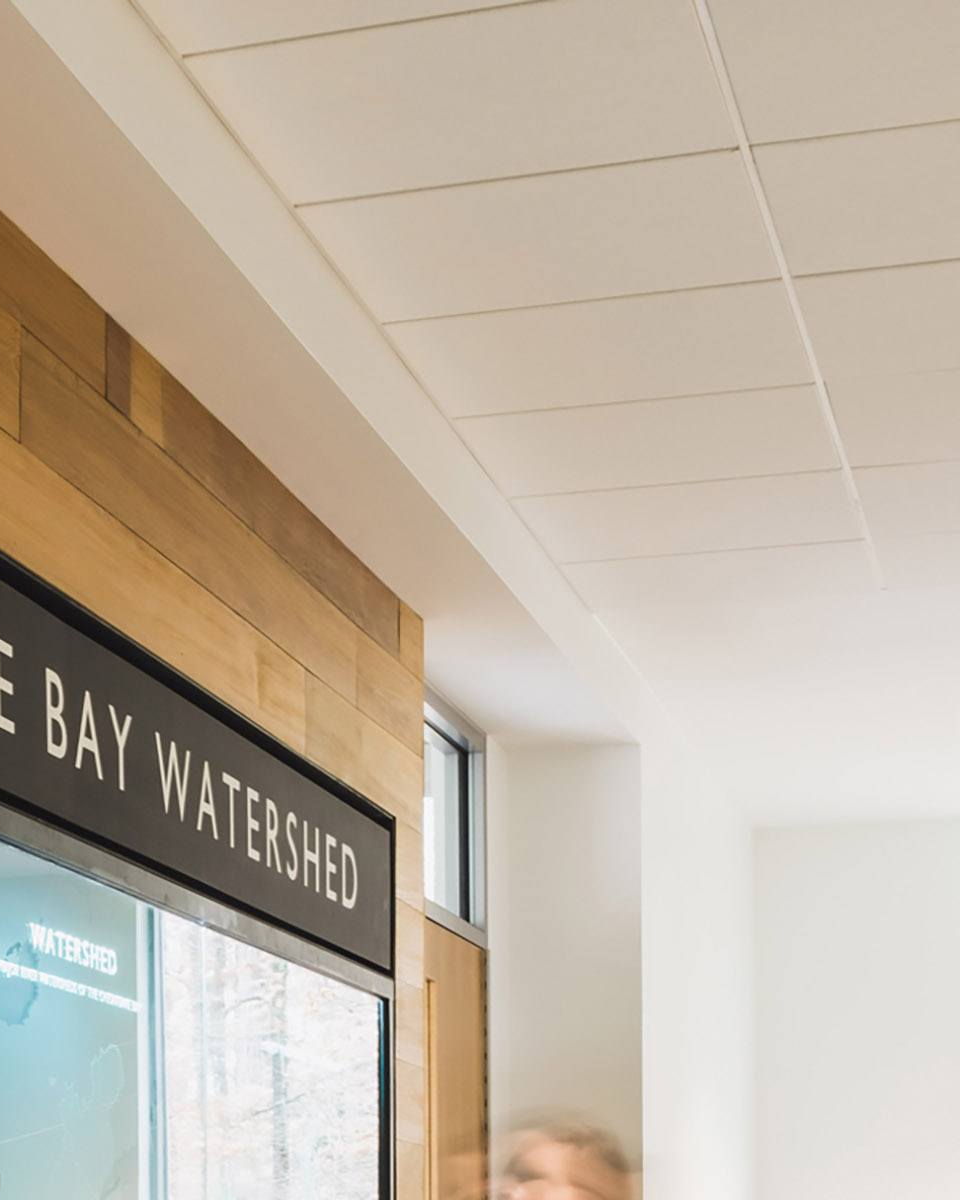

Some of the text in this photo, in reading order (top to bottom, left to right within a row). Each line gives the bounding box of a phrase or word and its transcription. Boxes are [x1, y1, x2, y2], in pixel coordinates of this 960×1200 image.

[45, 667, 132, 791] BAY
[155, 731, 358, 909] WATERSHED
[27, 921, 118, 977] WATERSHED
